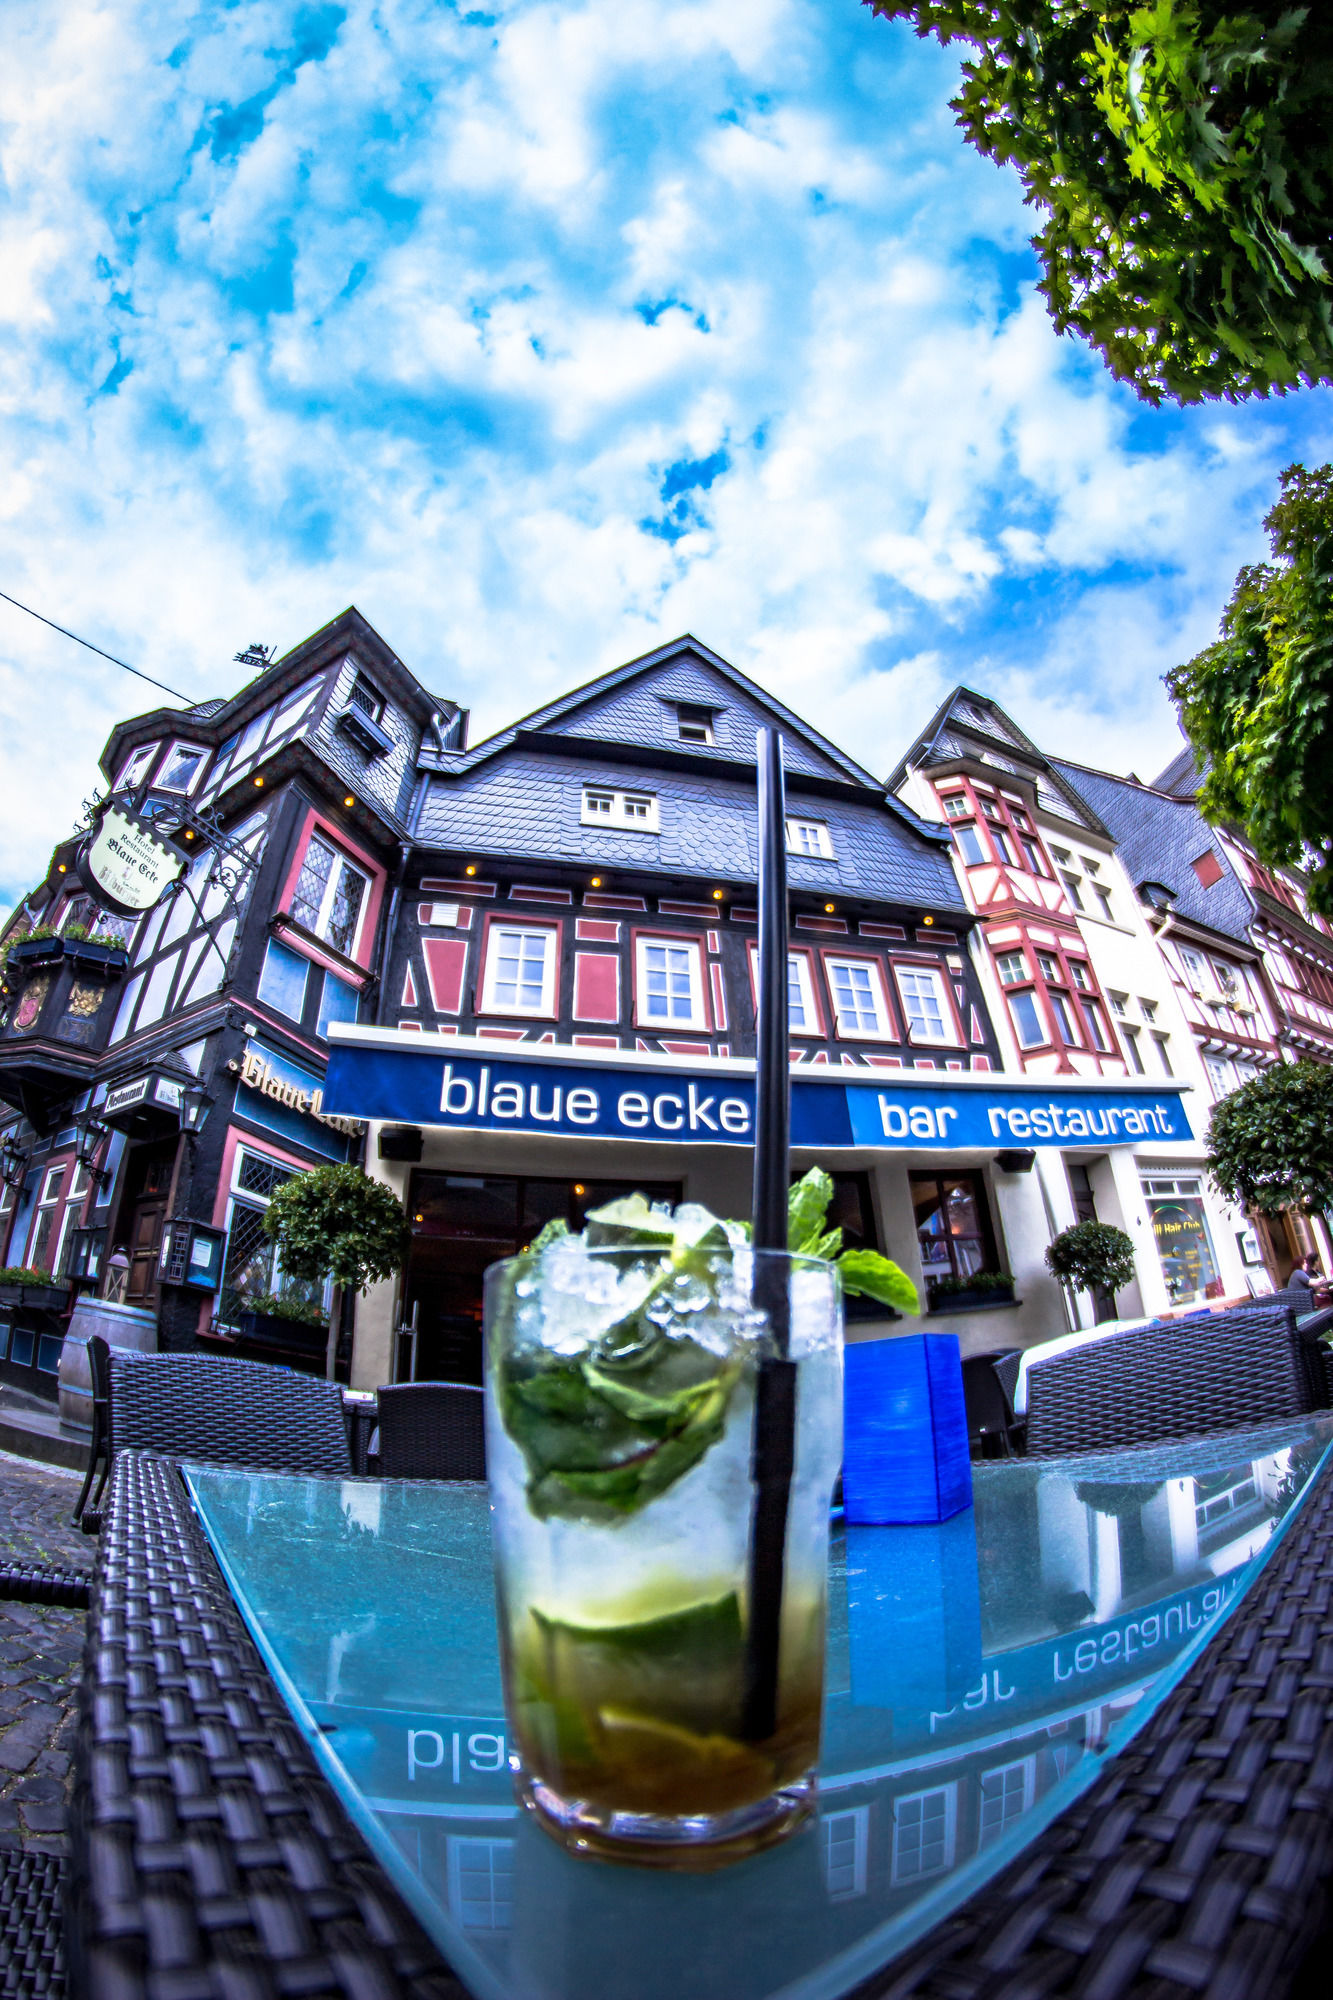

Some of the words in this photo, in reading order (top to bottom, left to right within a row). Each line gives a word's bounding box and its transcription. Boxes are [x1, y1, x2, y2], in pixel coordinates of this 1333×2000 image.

[106, 838, 137, 867] Blaue
[138, 863, 159, 884] Ecke
[120, 833, 159, 870] Restaurant
[134, 834, 156, 855] Hotel
[106, 1081, 145, 1109] Restaurant
[240, 1048, 307, 1114] Blaue
[439, 1063, 599, 1124] blaue
[616, 1082, 751, 1134] ecke
[877, 1094, 958, 1139] bar
[987, 1103, 1175, 1139] restaurant
